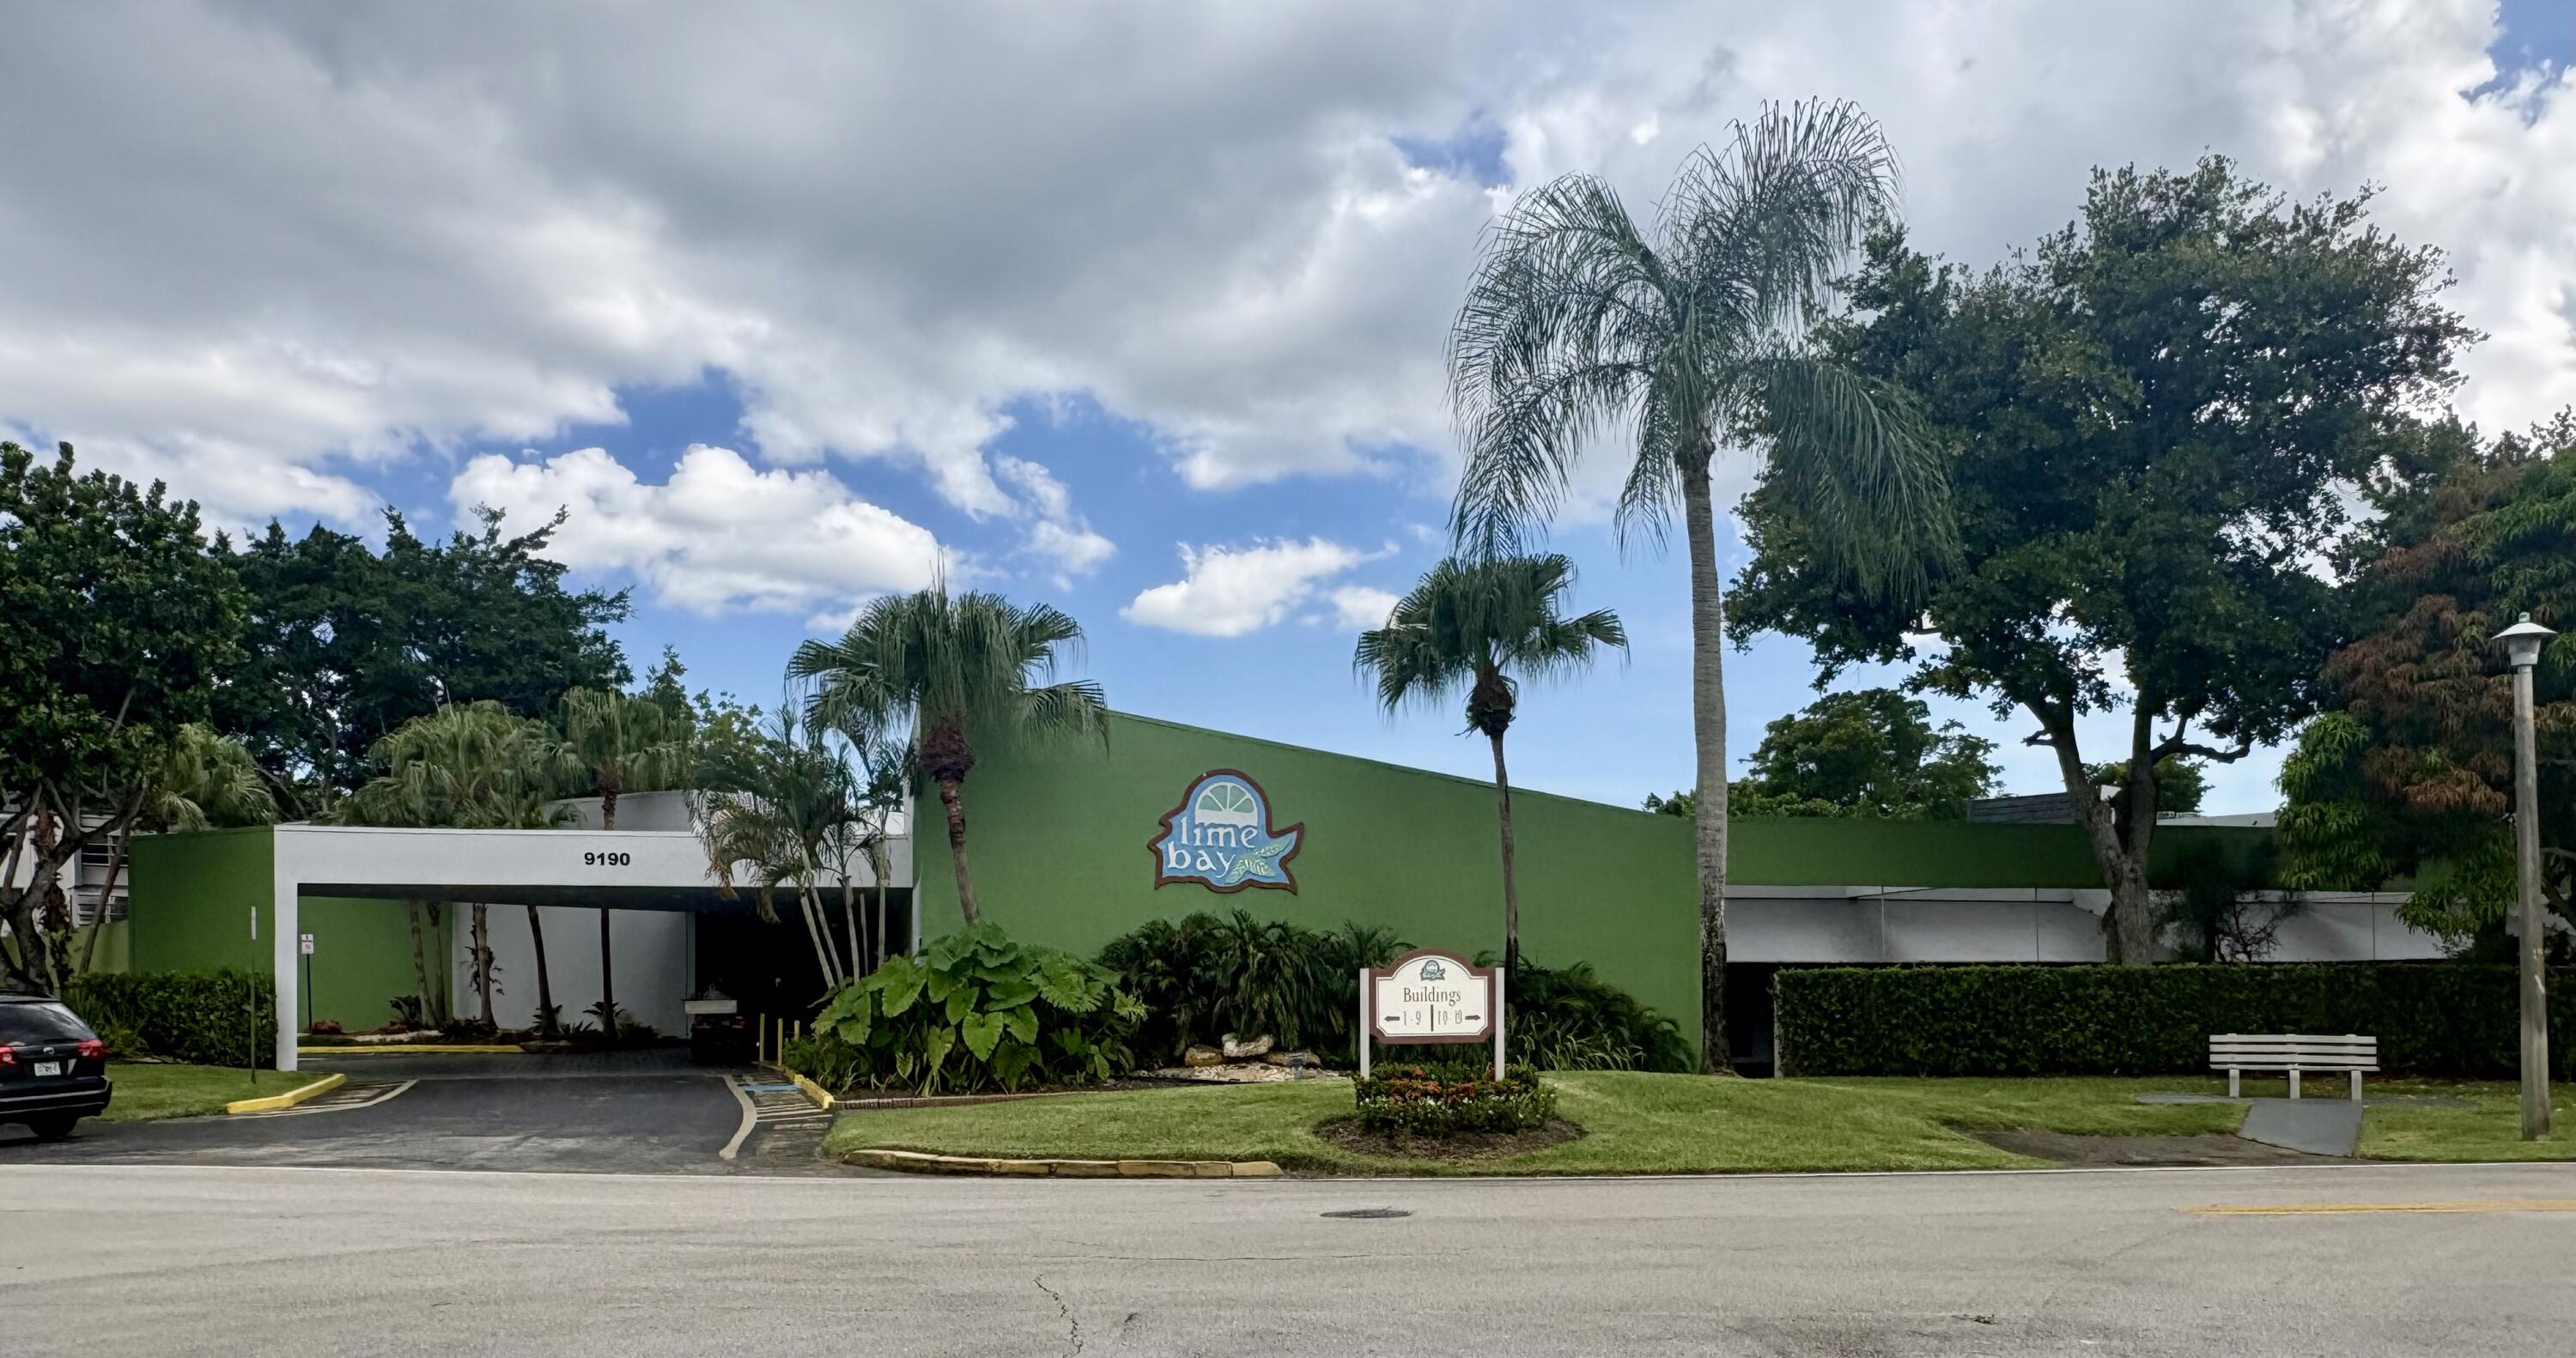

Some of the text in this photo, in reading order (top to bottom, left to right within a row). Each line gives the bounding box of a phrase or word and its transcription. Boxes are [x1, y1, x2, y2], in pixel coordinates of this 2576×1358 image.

[1181, 816, 1258, 848] lime
[584, 852, 630, 866] 9190
[1167, 840, 1236, 878] bay
[1403, 985, 1461, 1007] Buildings
